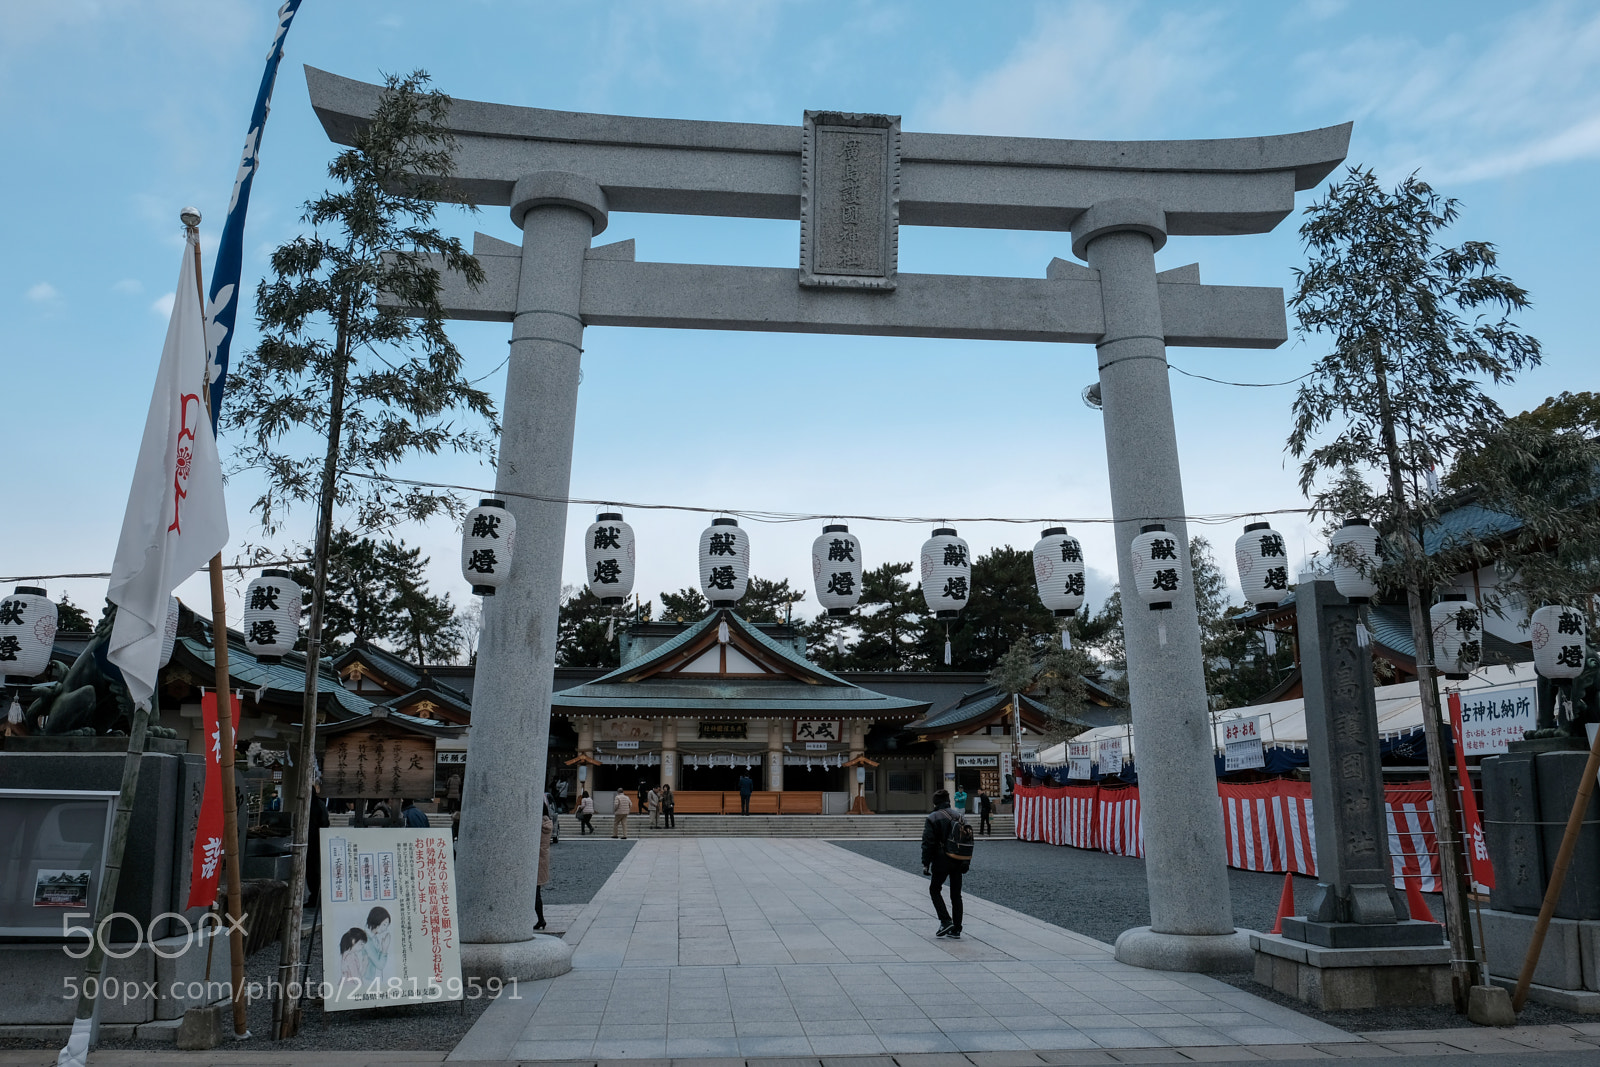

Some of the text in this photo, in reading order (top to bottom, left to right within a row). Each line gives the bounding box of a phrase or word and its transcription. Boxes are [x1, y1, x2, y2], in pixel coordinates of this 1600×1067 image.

[468, 513, 501, 574] 献燈
[593, 526, 622, 585] 献燈
[707, 532, 737, 590] 献燈
[827, 538, 856, 596] 献燈
[942, 543, 968, 600] 献燈
[1059, 539, 1085, 596] 献燈
[1150, 538, 1179, 591] 献燈
[1259, 534, 1288, 590] 献燈
[249, 585, 280, 645] 献燈
[1556, 612, 1584, 668] 献燈
[1461, 696, 1530, 723] 古神札納所
[408, 754, 424, 771] 定
[414, 838, 429, 937] おまつりしましょう
[436, 838, 452, 949] みんなの幸せを願って
